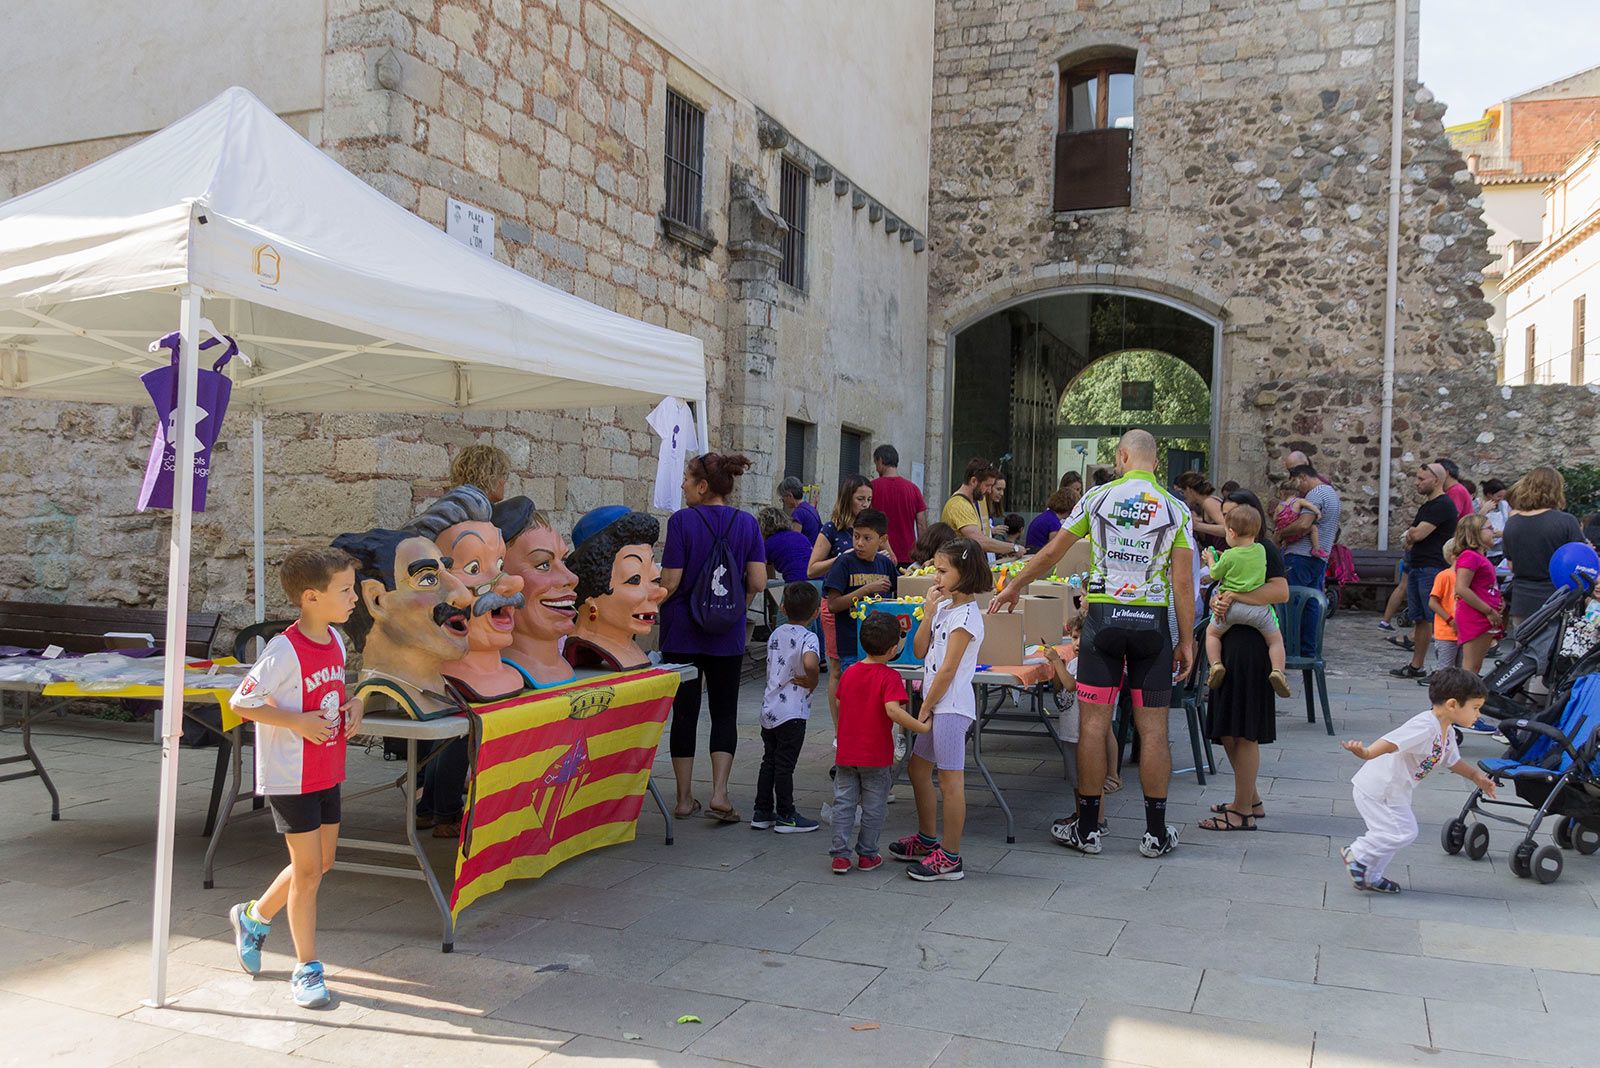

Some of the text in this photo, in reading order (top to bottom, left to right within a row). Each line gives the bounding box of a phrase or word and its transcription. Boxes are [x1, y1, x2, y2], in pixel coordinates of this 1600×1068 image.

[468, 210, 484, 224] PLAÇA
[473, 224, 479, 233] DE
[1113, 505, 1150, 520] lleida
[1133, 501, 1157, 511] ara
[1118, 537, 1151, 549] VILLART
[1107, 550, 1149, 563] CRISTEC
[1496, 661, 1524, 687] MACLAREN
